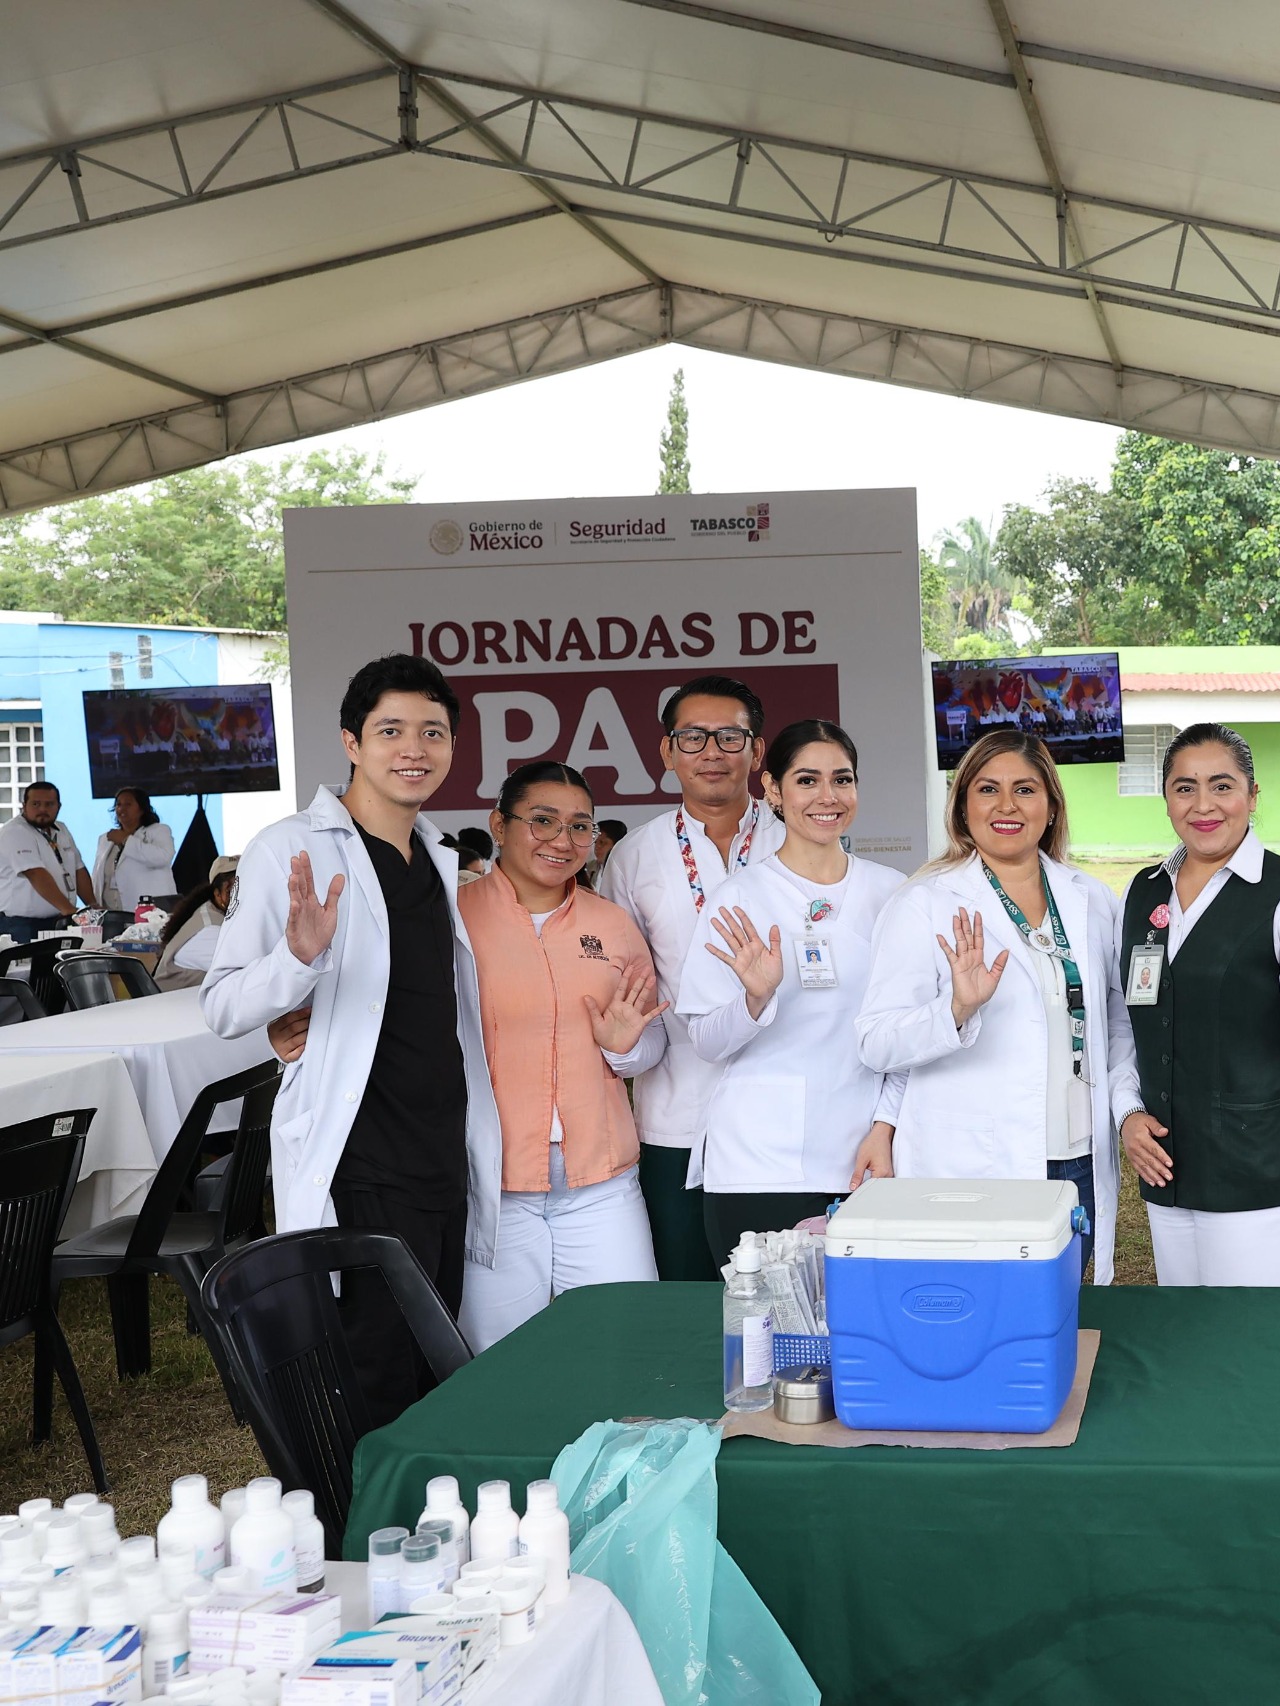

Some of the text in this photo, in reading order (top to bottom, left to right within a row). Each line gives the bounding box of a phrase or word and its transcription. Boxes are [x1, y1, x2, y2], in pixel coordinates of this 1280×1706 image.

[469, 520, 543, 533] Gobierno de
[569, 518, 666, 540] Seguridad
[690, 517, 756, 531] TABASCO
[469, 532, 543, 551] México
[408, 610, 817, 666] JORNADAS DE
[472, 686, 684, 799] PA
[1020, 1246, 1030, 1259] 5
[397, 1634, 449, 1643] BRUPEN
